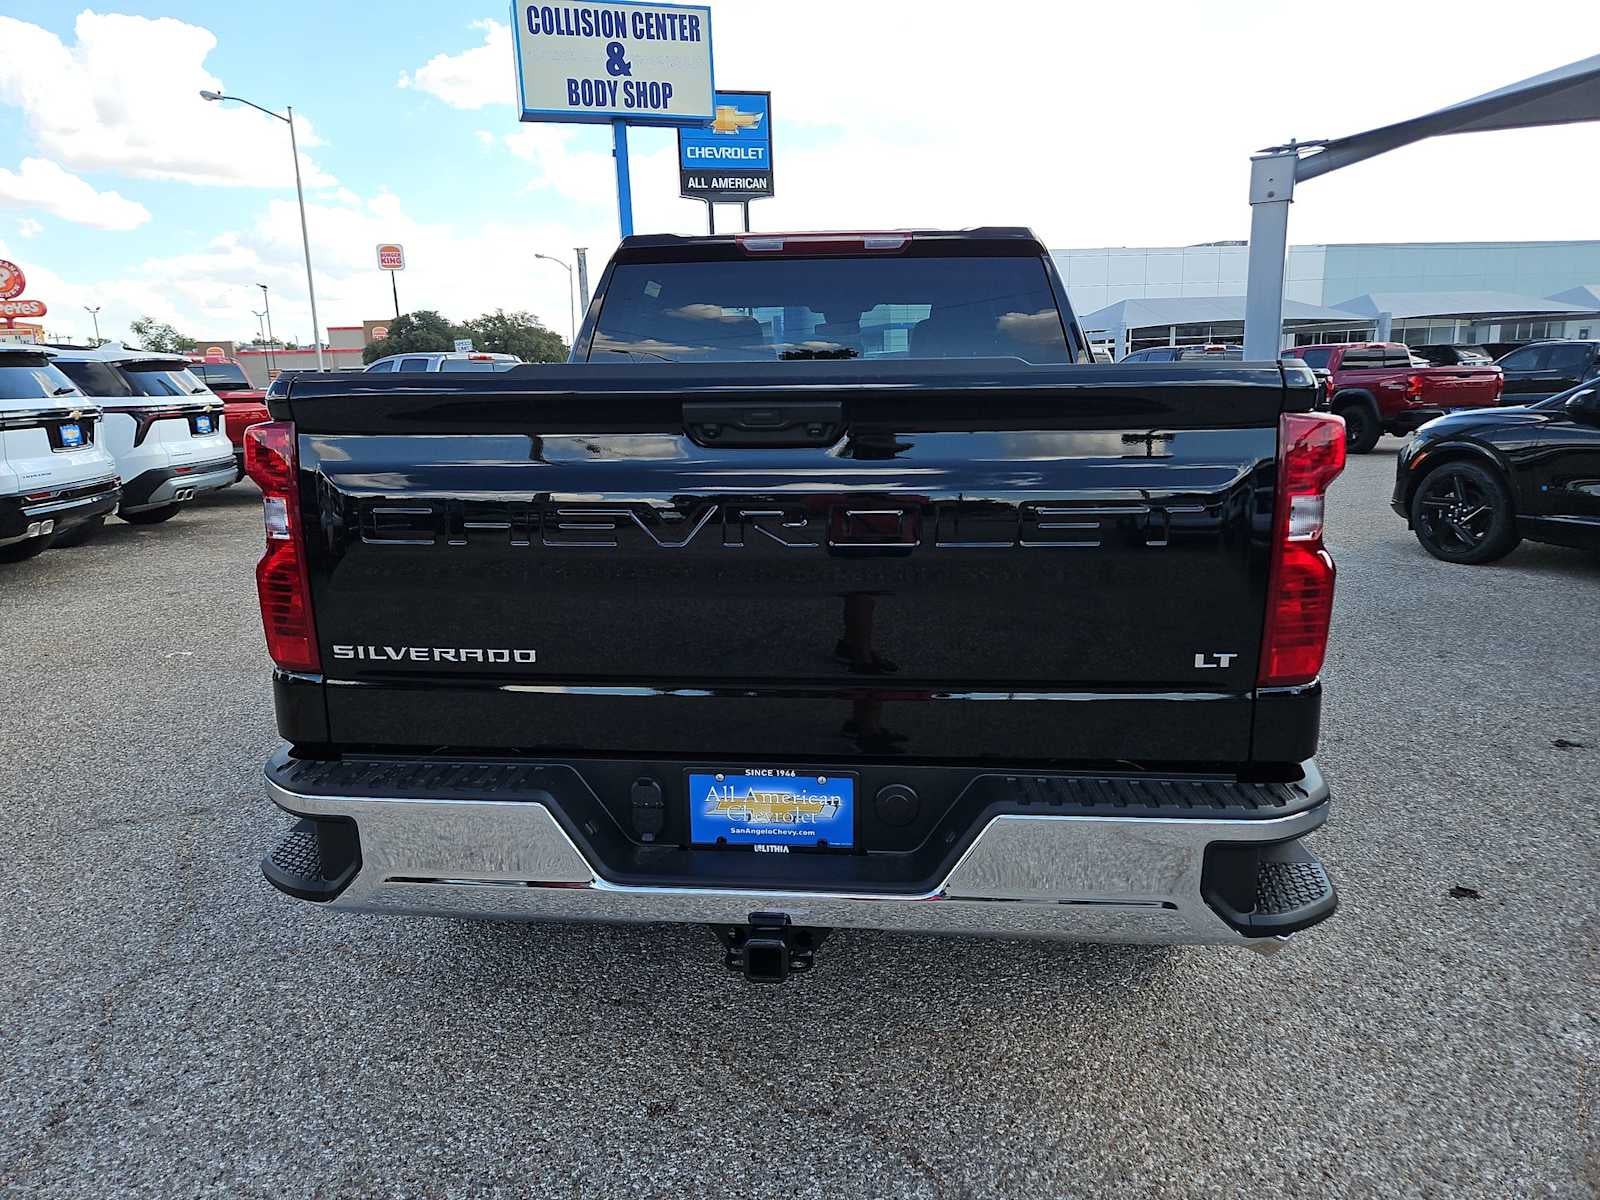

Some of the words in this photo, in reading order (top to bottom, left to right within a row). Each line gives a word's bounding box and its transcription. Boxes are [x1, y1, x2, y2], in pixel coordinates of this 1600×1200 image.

[526, 5, 627, 39] COLLISION
[631, 11, 701, 42] CENTER
[606, 41, 632, 77] &
[567, 78, 618, 107] BODY
[623, 80, 673, 109] SHOP
[686, 146, 764, 160] CHEVROLET
[688, 176, 708, 189] ALL
[711, 177, 767, 189] AMERICAN
[380, 257, 402, 265] KING
[362, 504, 1207, 549] CHEVROLET
[333, 645, 536, 663] SILVERADO
[1194, 653, 1238, 668] LT
[745, 769, 773, 777] SINCE
[705, 785, 735, 802] All
[747, 786, 842, 806] American
[726, 804, 817, 824] Chevrolet
[730, 827, 816, 837] SanAngeloChevy.com
